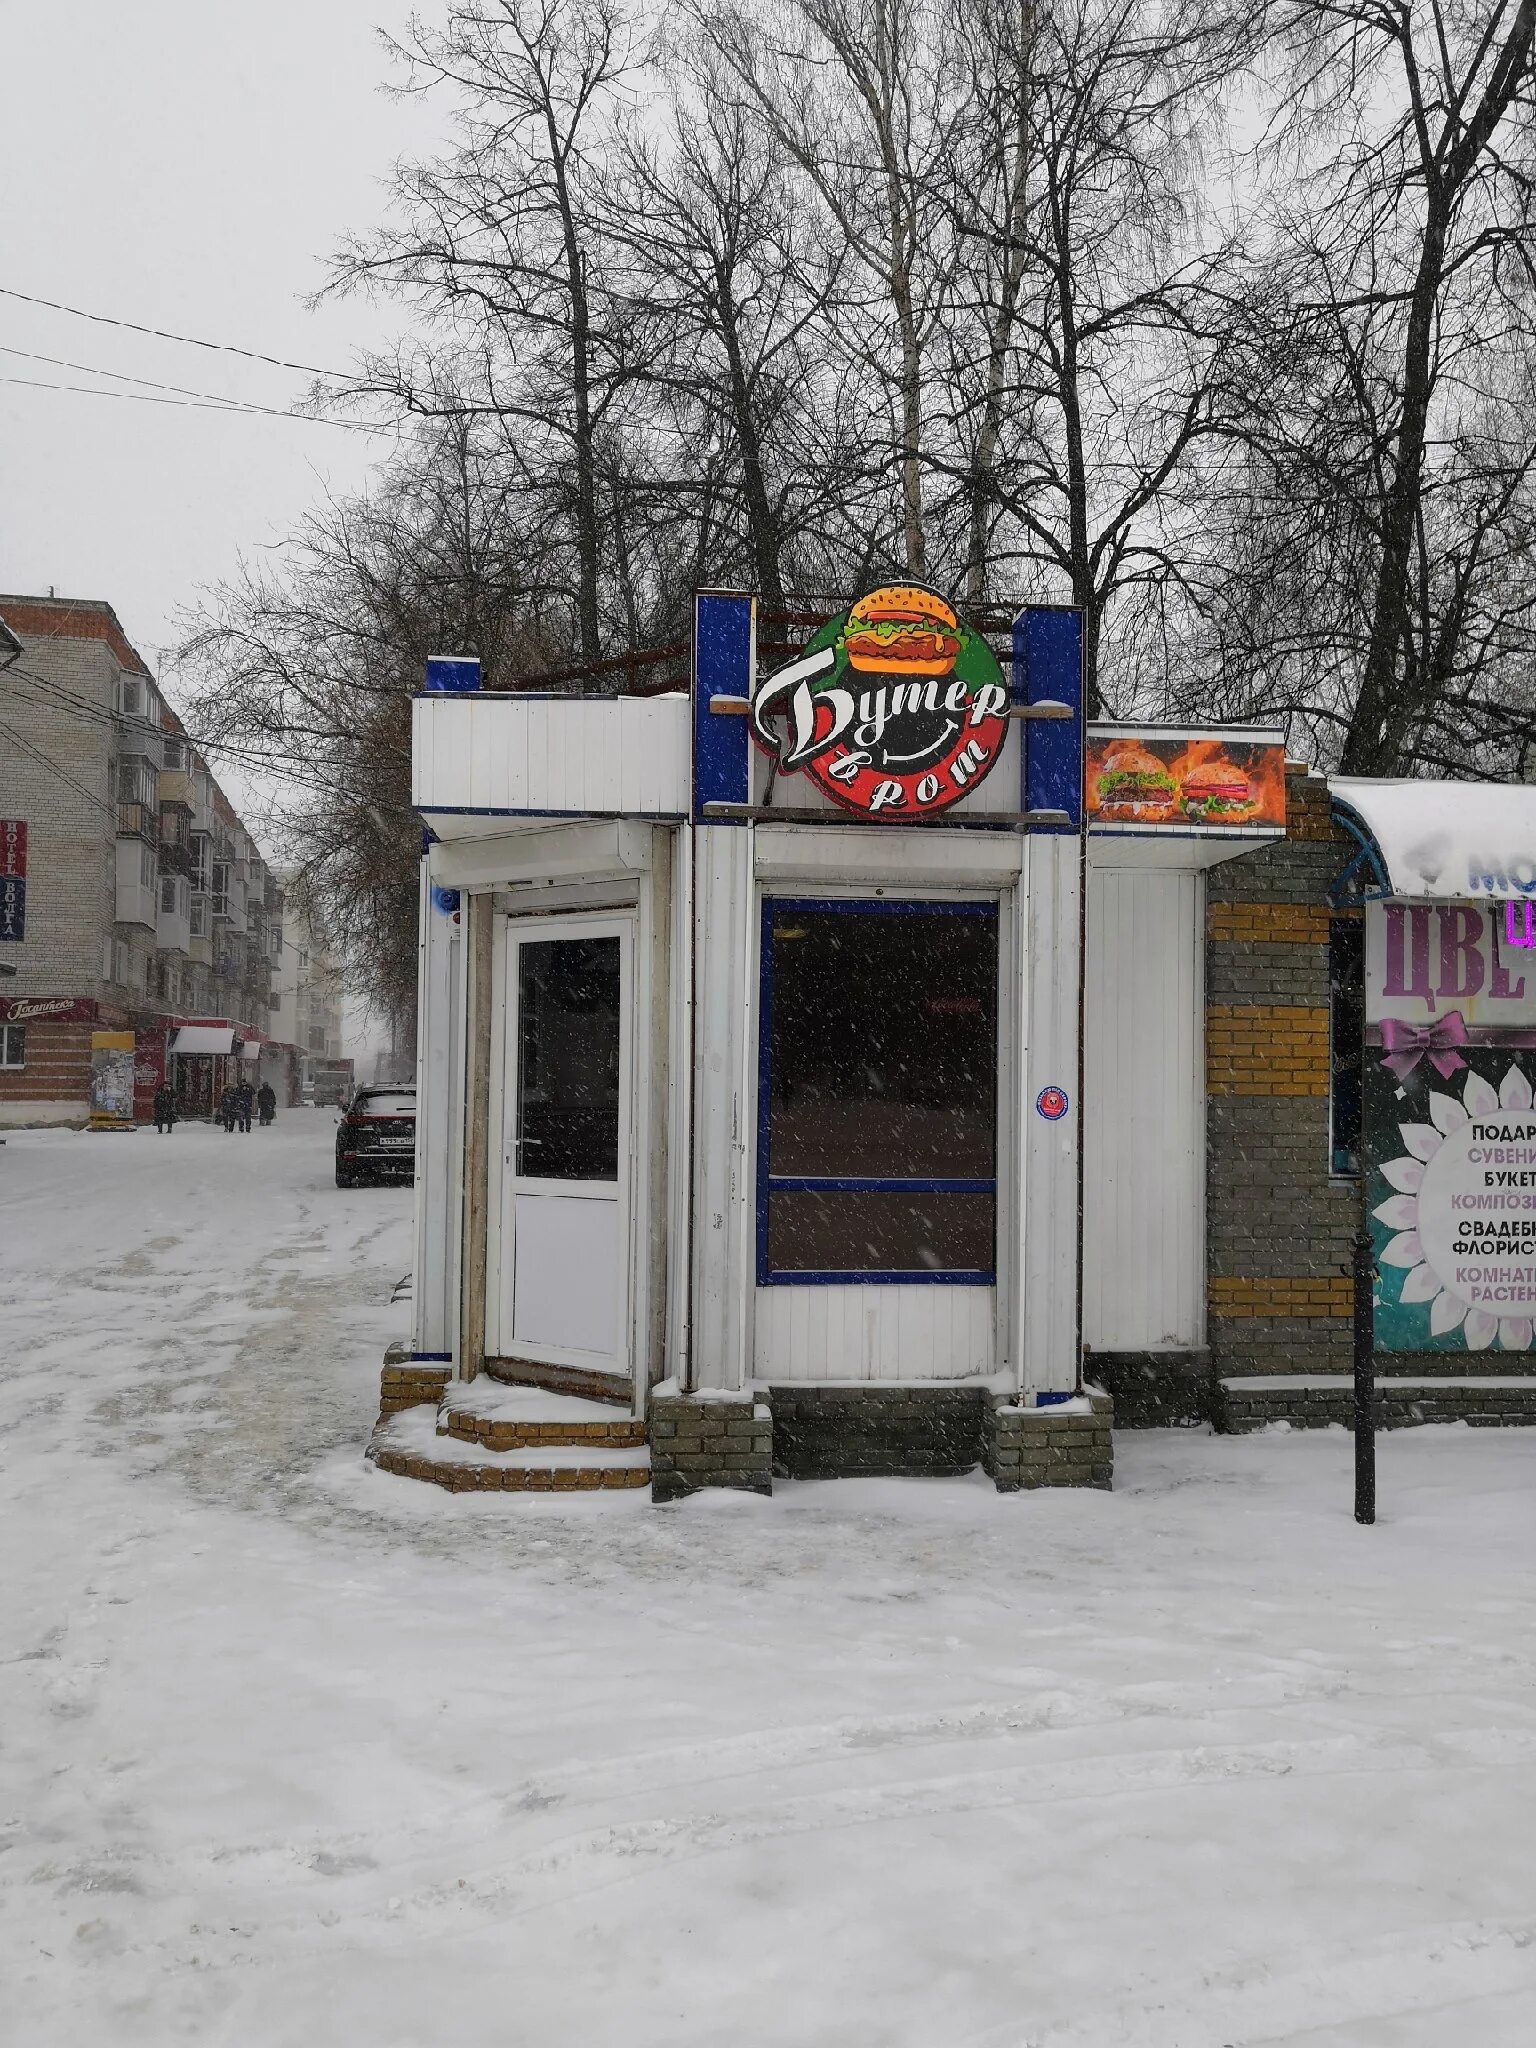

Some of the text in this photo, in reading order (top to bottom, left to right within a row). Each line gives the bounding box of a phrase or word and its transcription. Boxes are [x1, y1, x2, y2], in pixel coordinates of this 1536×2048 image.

[755, 647, 1012, 762] Бутер
[828, 739, 990, 811] в рот
[5, 822, 18, 875] HOTEL
[4, 882, 17, 935] ВОЛГА
[7, 1000, 76, 1020] Госаптека
[1472, 1125, 1536, 1142] ПОДАР
[1484, 1172, 1536, 1187] БУКЕТ
[1453, 1240, 1536, 1255] ФЛОРИС
[1456, 1267, 1536, 1282] КОМНАТ
